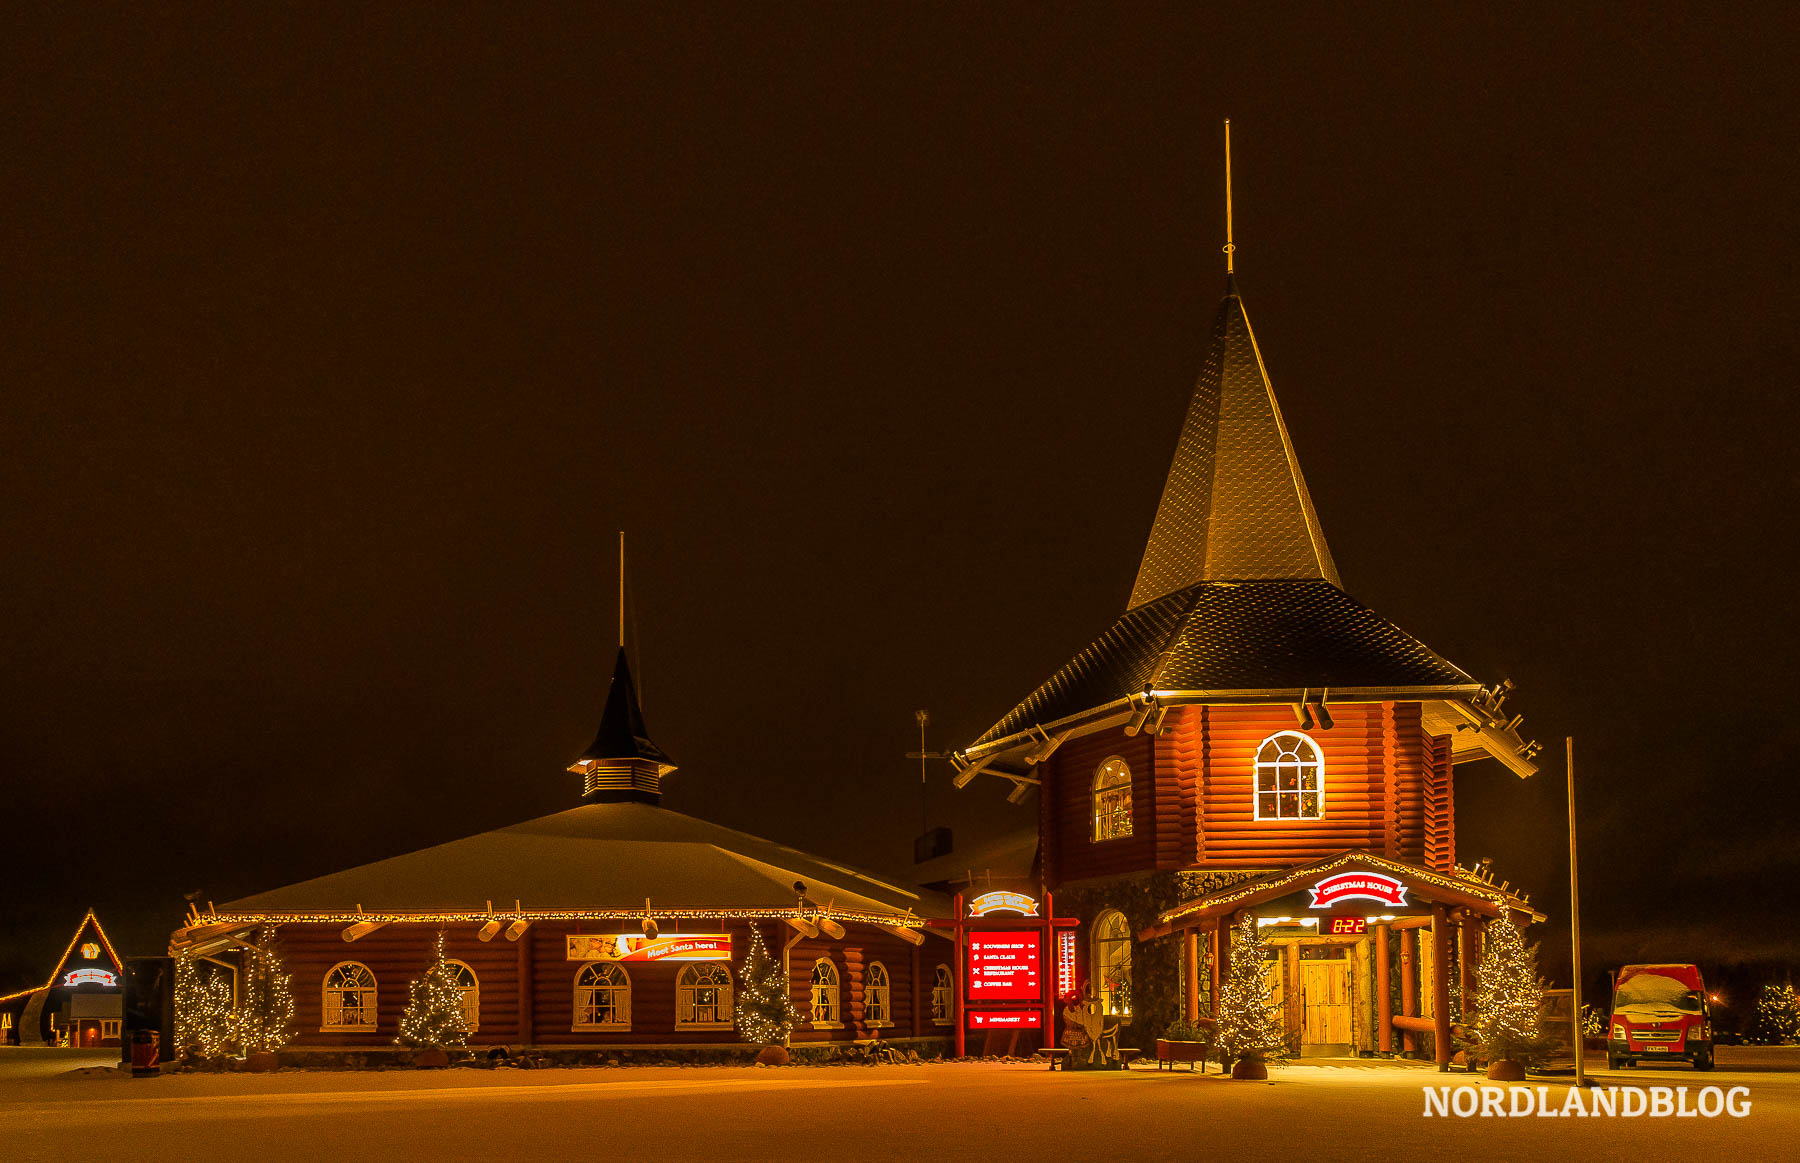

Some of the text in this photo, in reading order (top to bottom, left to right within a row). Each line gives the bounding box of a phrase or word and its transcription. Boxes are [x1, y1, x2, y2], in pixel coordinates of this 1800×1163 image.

[1322, 881, 1393, 895] CHRISTMAS HOUSE
[647, 946, 668, 959] Meet
[670, 944, 693, 953] Santa
